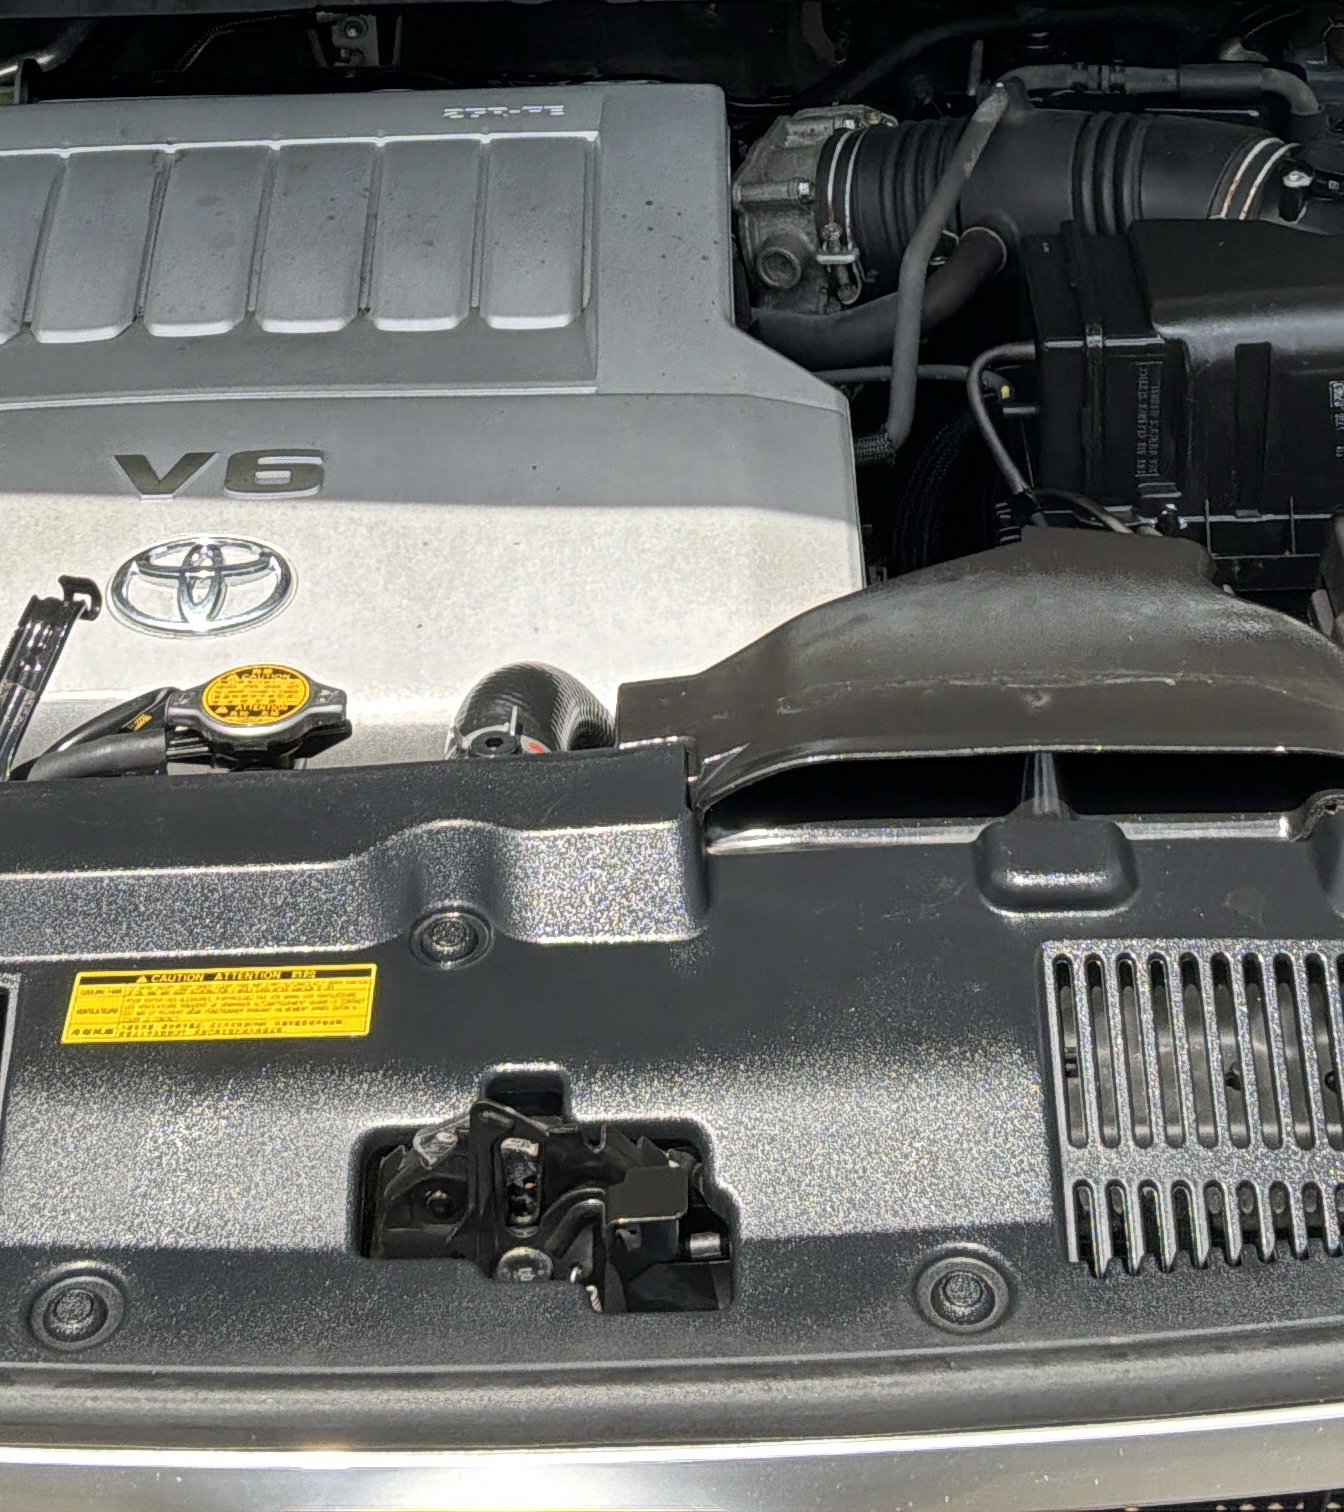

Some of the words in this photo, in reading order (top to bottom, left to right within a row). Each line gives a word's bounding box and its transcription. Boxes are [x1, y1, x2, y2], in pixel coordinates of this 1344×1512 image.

[113, 448, 325, 498] V6
[151, 973, 205, 983] CAUTION
[214, 970, 282, 981] ATTENTION
